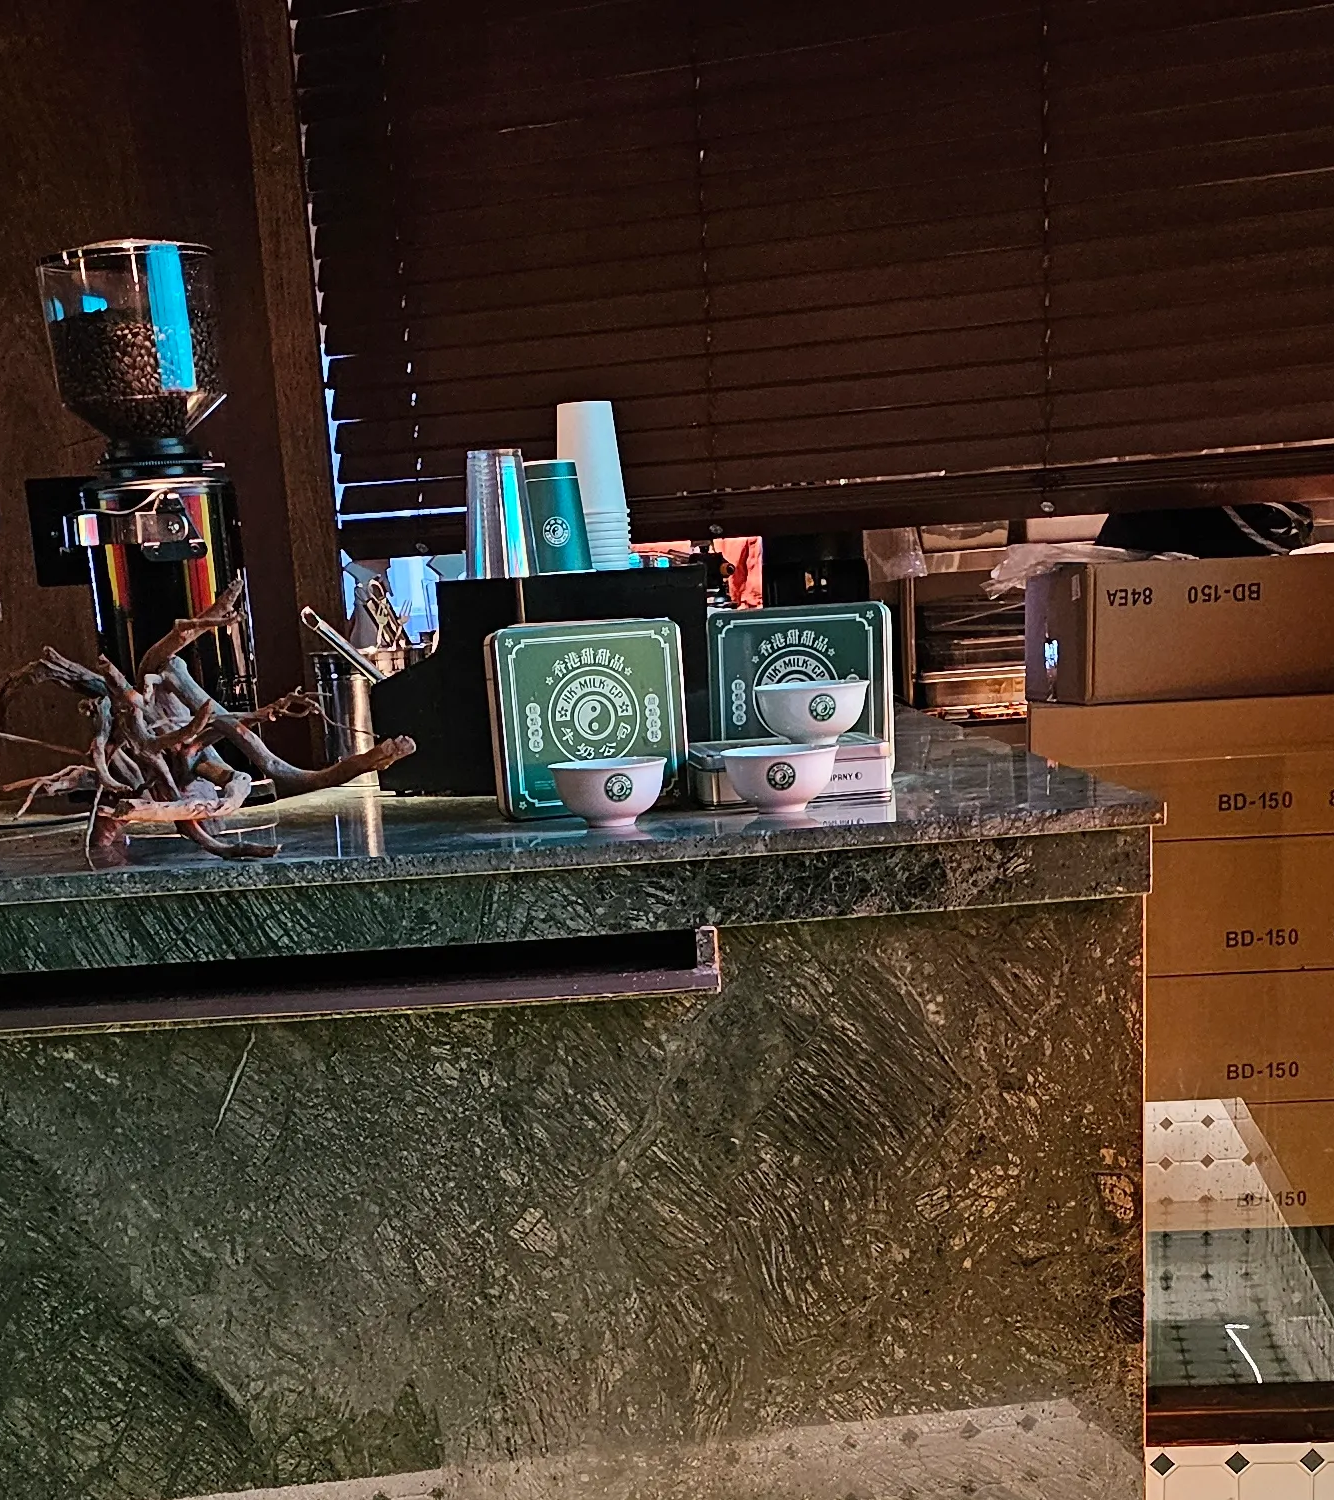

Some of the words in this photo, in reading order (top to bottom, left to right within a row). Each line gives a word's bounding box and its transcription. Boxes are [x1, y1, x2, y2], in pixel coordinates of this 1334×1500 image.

[1106, 587, 1153, 607] 84EA
[1187, 582, 1261, 604] BD-150
[1218, 791, 1293, 812] BD-150
[1225, 928, 1299, 949] BD-150
[1226, 1061, 1300, 1080] BD-150
